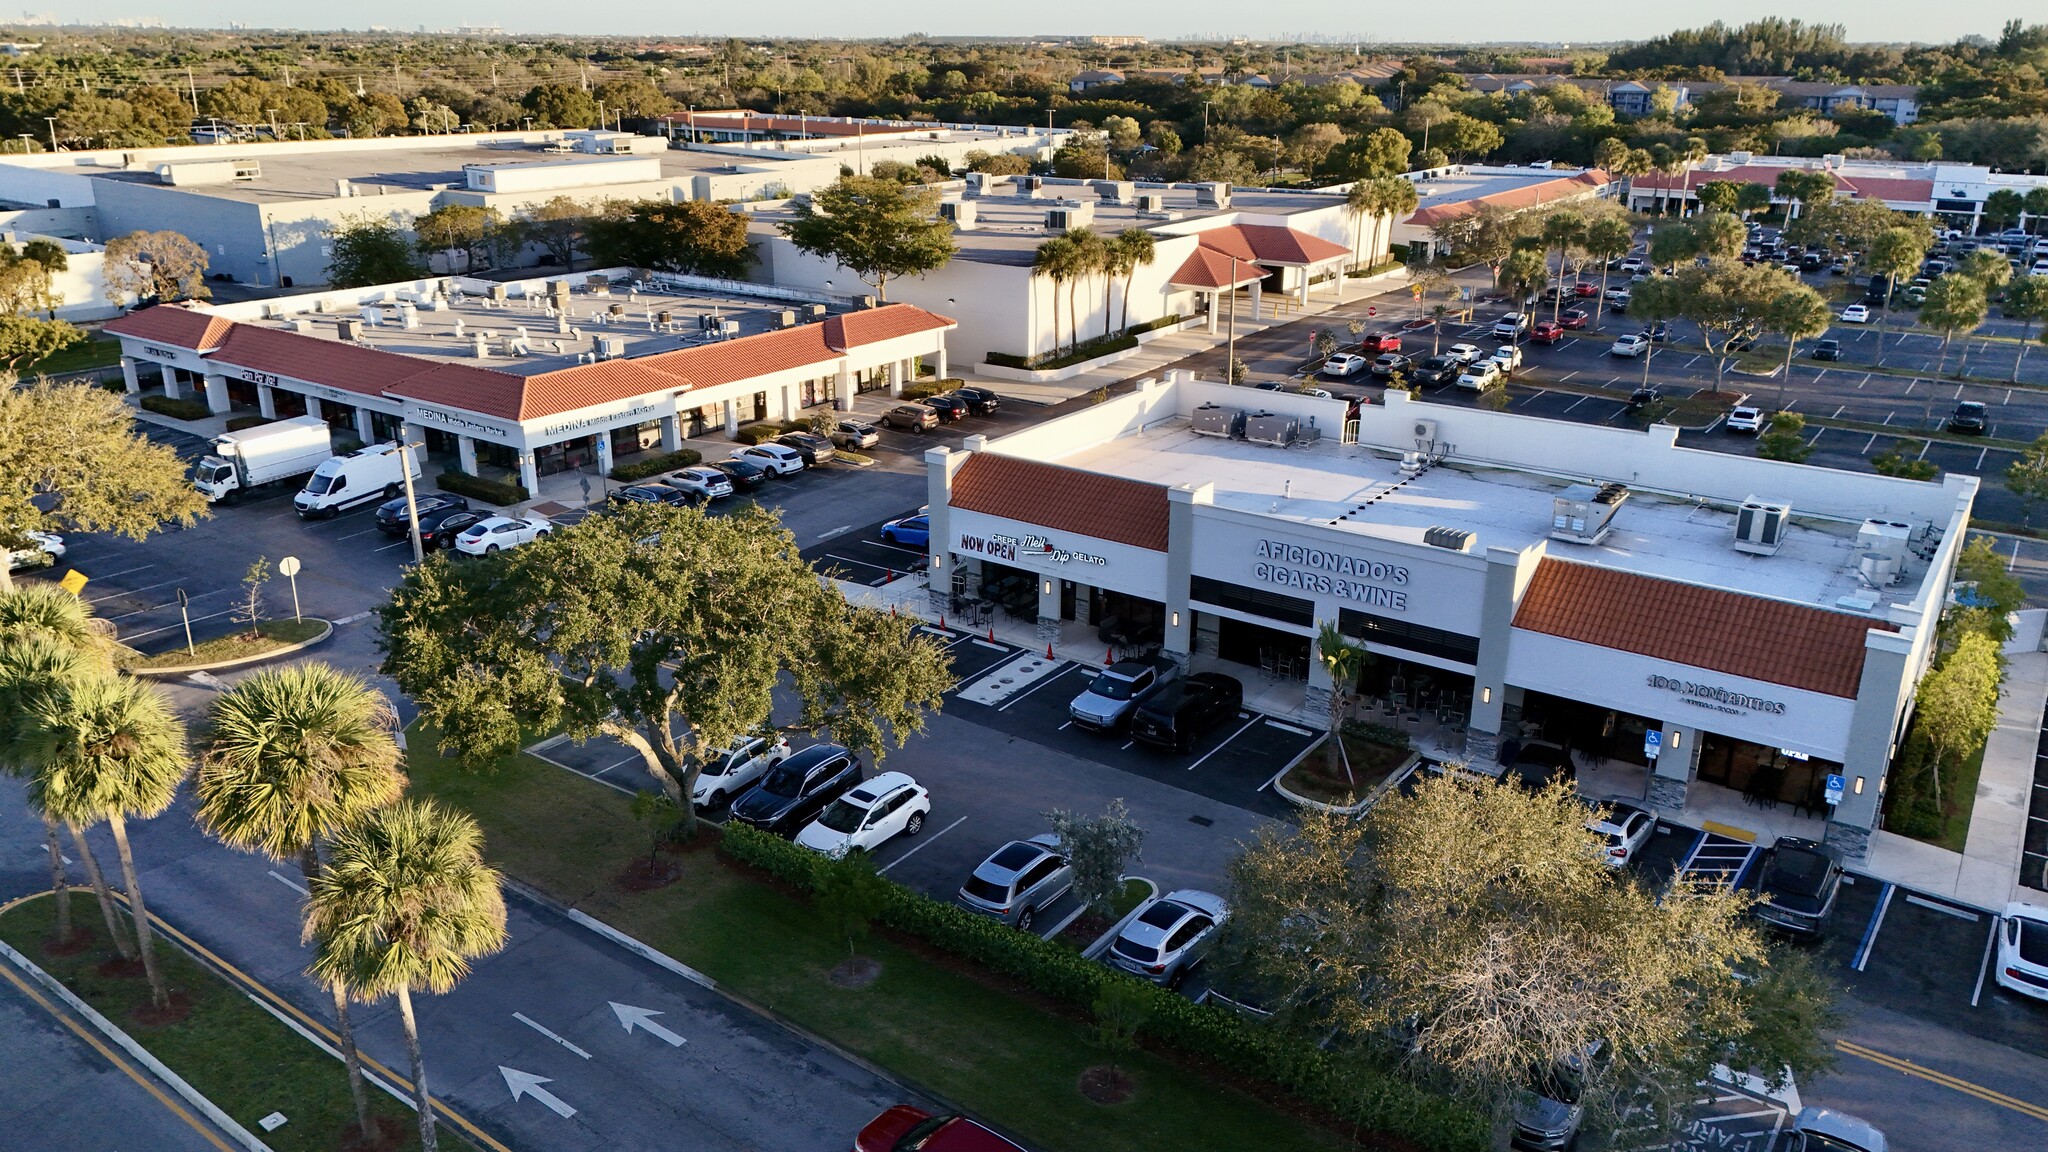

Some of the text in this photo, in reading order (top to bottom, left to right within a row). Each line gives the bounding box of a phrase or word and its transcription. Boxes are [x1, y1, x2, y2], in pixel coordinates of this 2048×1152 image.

[241, 369, 253, 380] Pan
[417, 408, 505, 437] MEDINA Middle Eastern Market
[545, 418, 588, 436] MEDINA
[610, 410, 634, 423] Eastern
[961, 534, 1016, 561] NOW OPEN
[991, 534, 1046, 548] CREPE Melt
[1049, 548, 1106, 566] Dip GELATO
[1255, 539, 1410, 586] AFICIONADO'S
[1253, 562, 1331, 595] CIGARS
